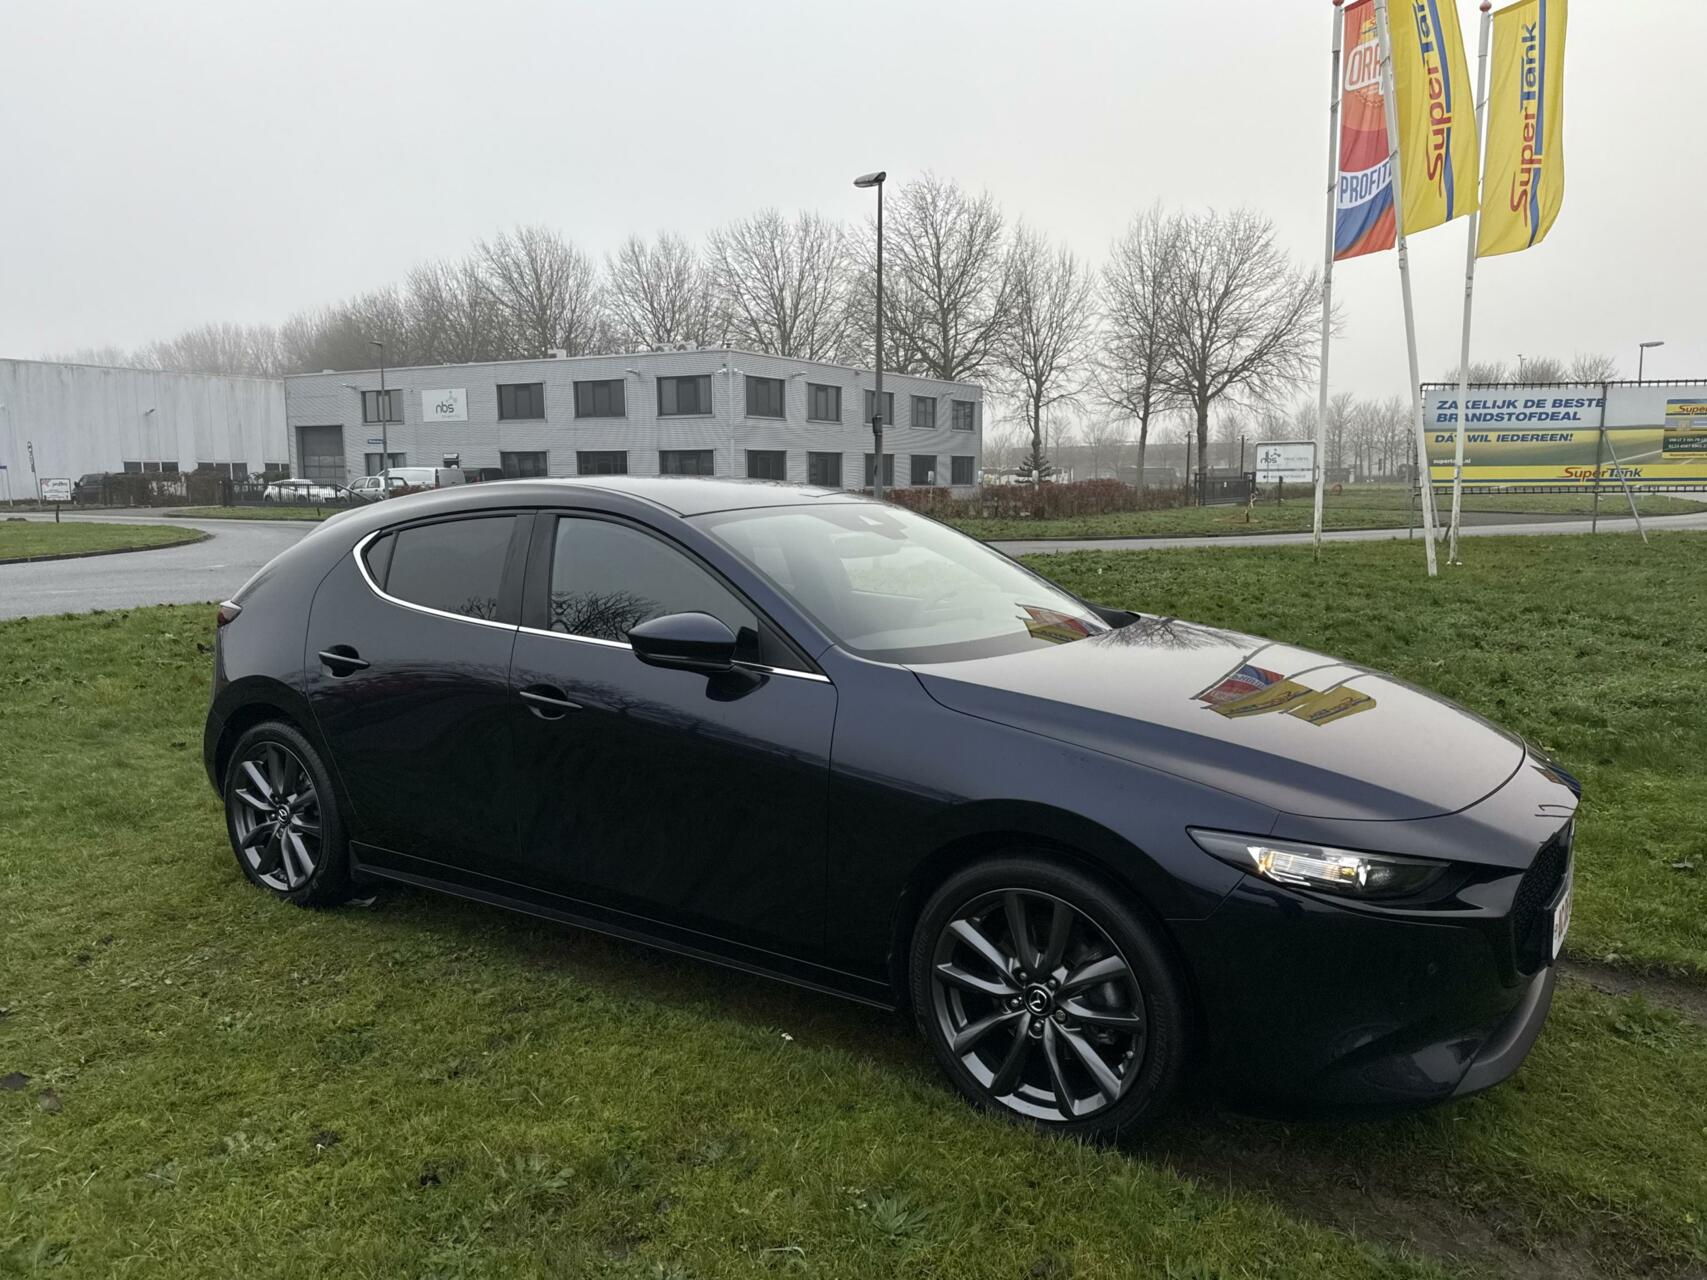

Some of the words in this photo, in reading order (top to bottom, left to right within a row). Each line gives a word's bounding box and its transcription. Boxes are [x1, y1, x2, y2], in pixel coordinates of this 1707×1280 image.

[1510, 21, 1542, 228] SuperTank
[1340, 160, 1392, 203] PROFIT
[435, 400, 455, 414] nbs
[1523, 398, 1547, 409] DE
[1551, 397, 1605, 409] BESTE
[1434, 432, 1457, 443] DÁ
[1467, 434, 1492, 443] WIL
[1496, 433, 1574, 443] IEDEREEN!
